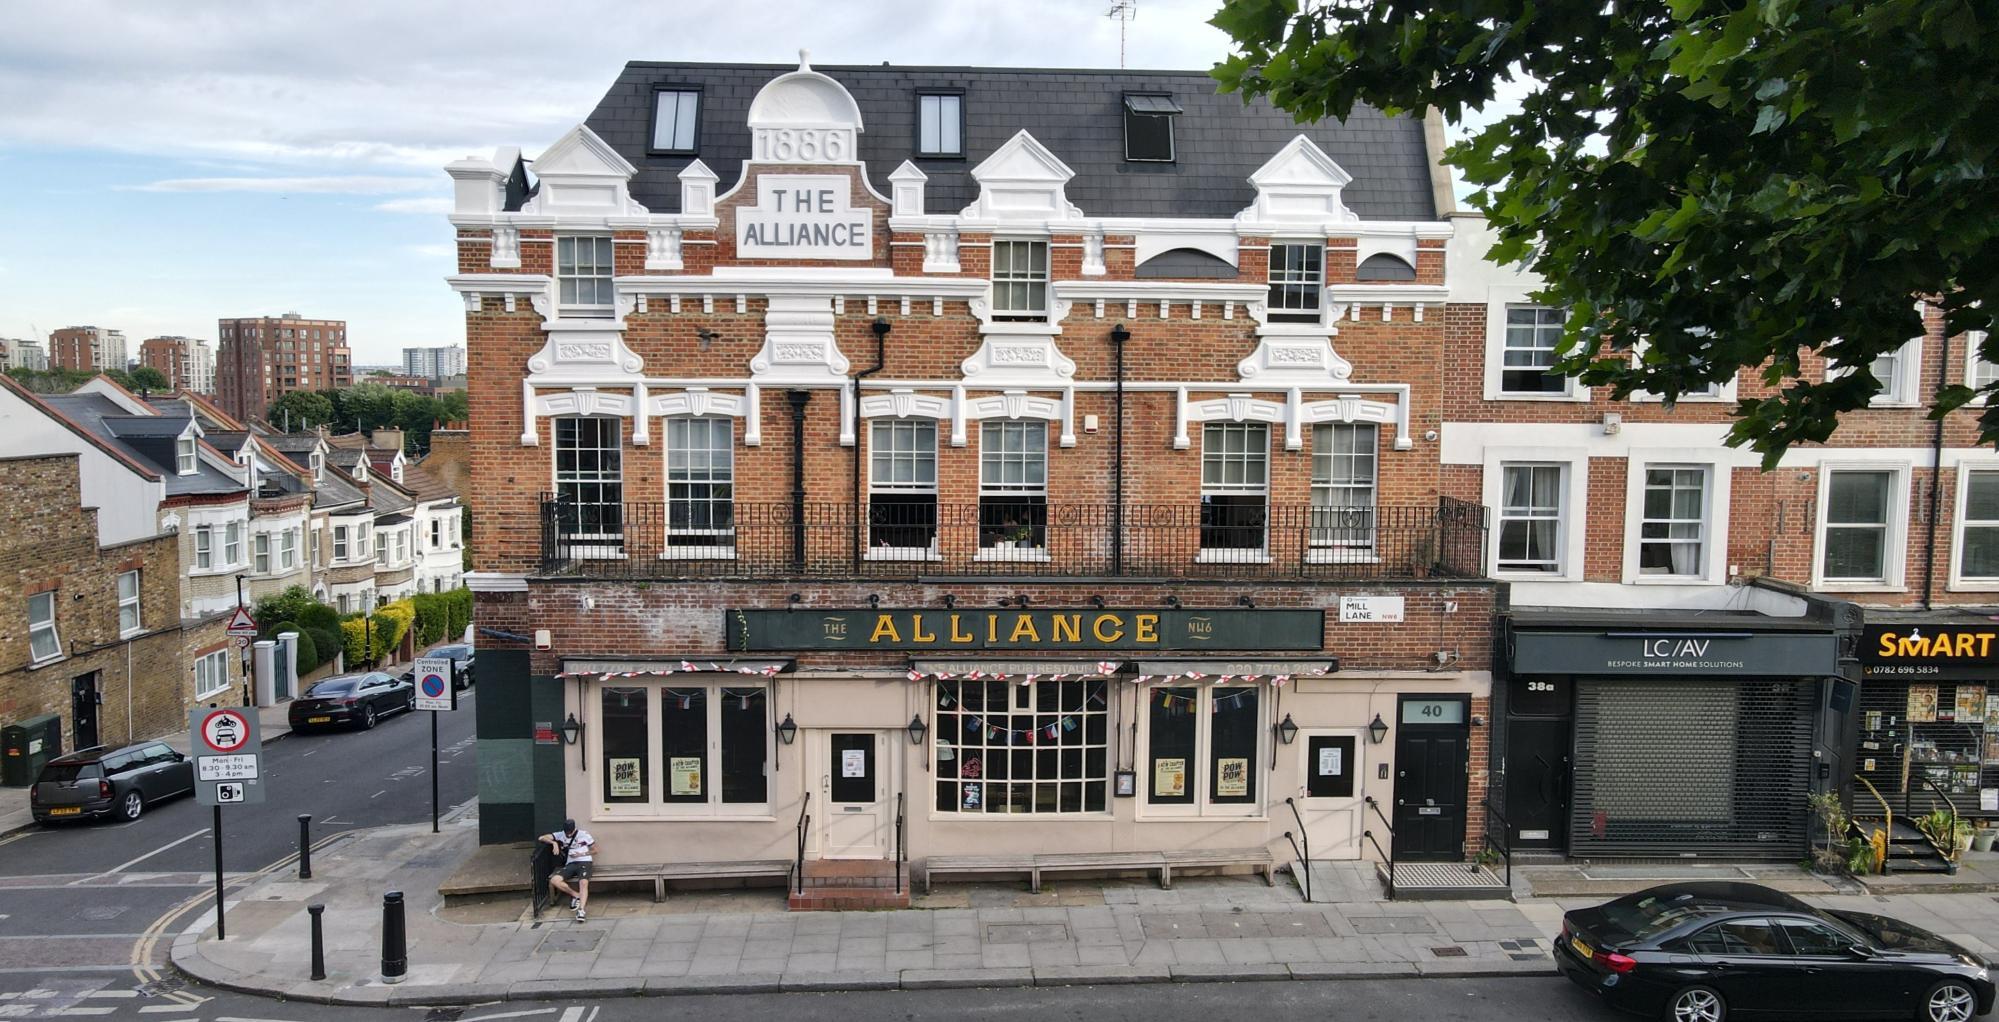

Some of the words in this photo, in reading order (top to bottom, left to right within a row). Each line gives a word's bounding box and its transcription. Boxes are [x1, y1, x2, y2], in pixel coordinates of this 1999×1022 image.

[759, 129, 841, 161] 1886
[772, 189, 834, 213] THE
[743, 222, 865, 247] ALLIANCE
[1346, 602, 1368, 610] MILL
[1345, 611, 1372, 620] LANE
[823, 623, 847, 634] THE
[869, 614, 1161, 643] ALLIANCE
[1188, 622, 1212, 633] NW6
[949, 663, 1004, 674] ALLIANCE
[1009, 663, 1033, 674] PUB
[1227, 663, 1252, 674] 020
[1255, 663, 1290, 674] 7794
[1607, 660, 1641, 668] BESPOKE
[1643, 660, 1672, 668] SMART
[1673, 660, 1697, 668] HOME
[1699, 660, 1744, 668] SOLUTIONS
[1873, 666, 1896, 674] 0782
[1897, 666, 1915, 674] 696
[1916, 666, 1939, 674] 5834
[1527, 681, 1555, 692] 38a
[1421, 705, 1443, 717] 40
[616, 762, 635, 772] POW
[1223, 762, 1243, 772] POW
[615, 771, 634, 781] POW
[1222, 771, 1241, 781] POW
